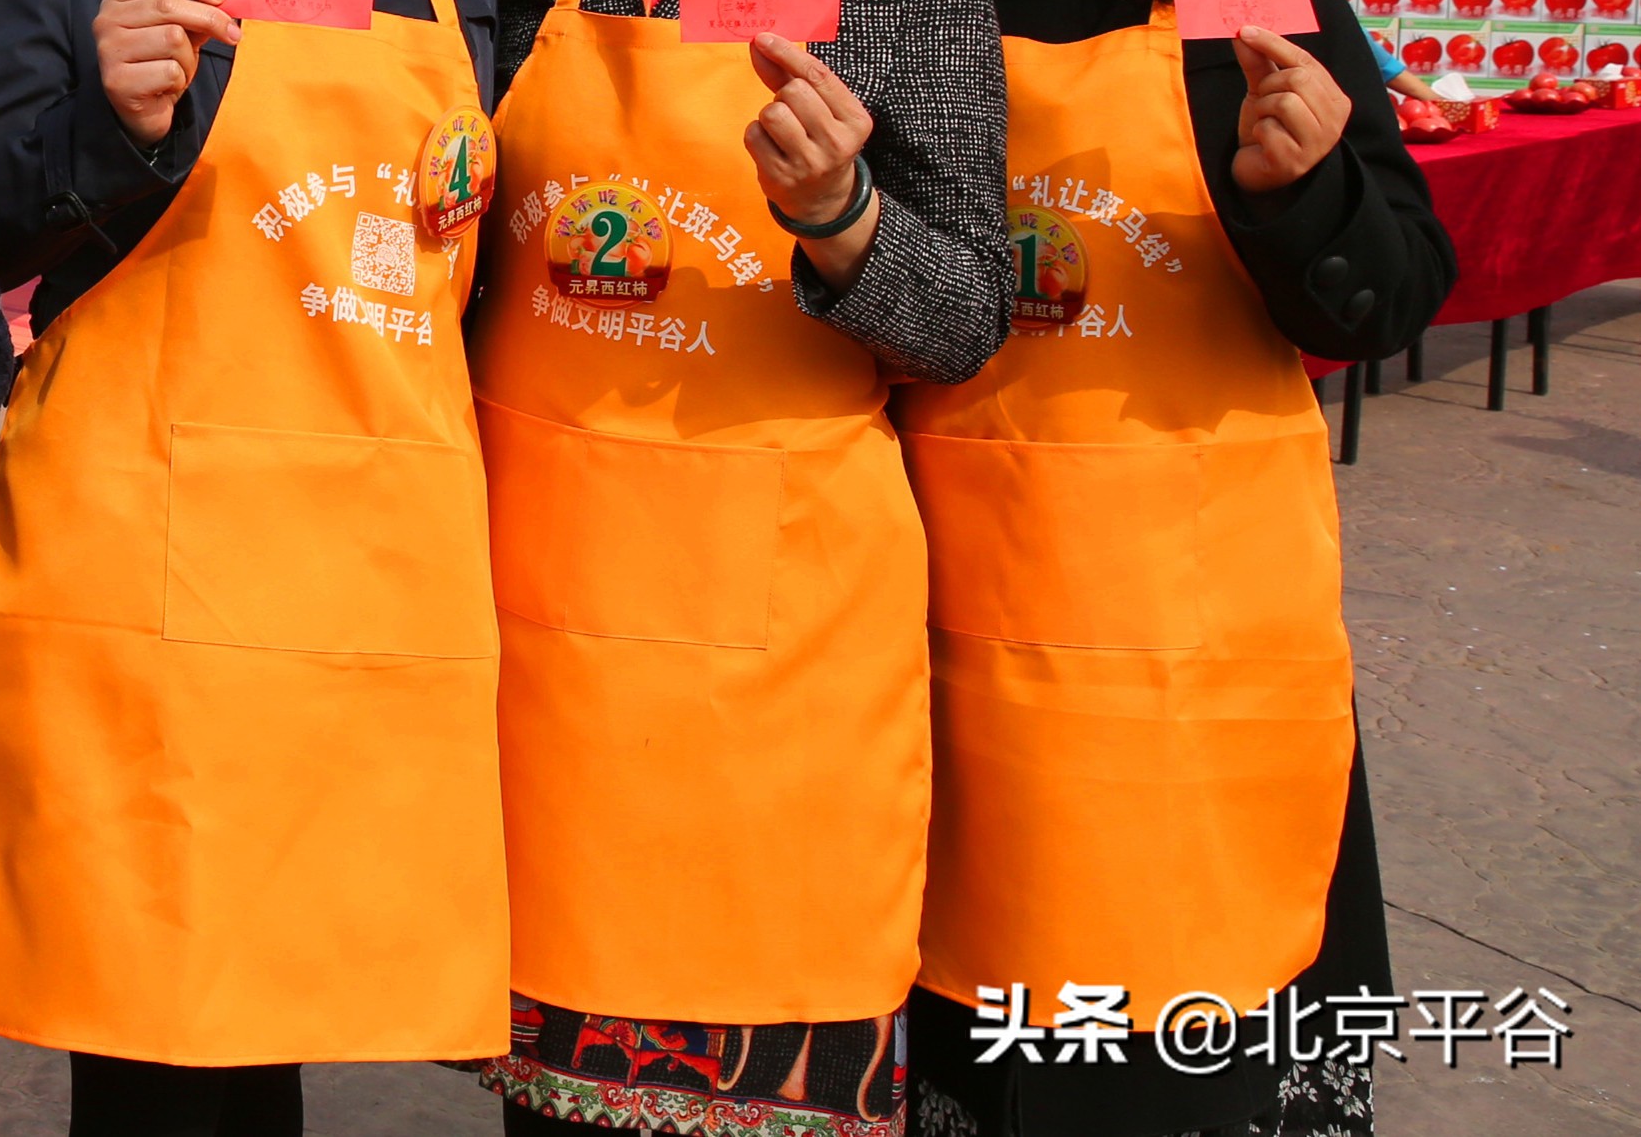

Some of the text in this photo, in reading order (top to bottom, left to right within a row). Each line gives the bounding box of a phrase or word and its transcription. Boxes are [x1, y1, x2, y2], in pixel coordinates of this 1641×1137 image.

[449, 135, 472, 203] 4
[591, 210, 628, 276] 2
[1015, 234, 1048, 299] 1
[569, 279, 648, 297] 元昇西红柿
